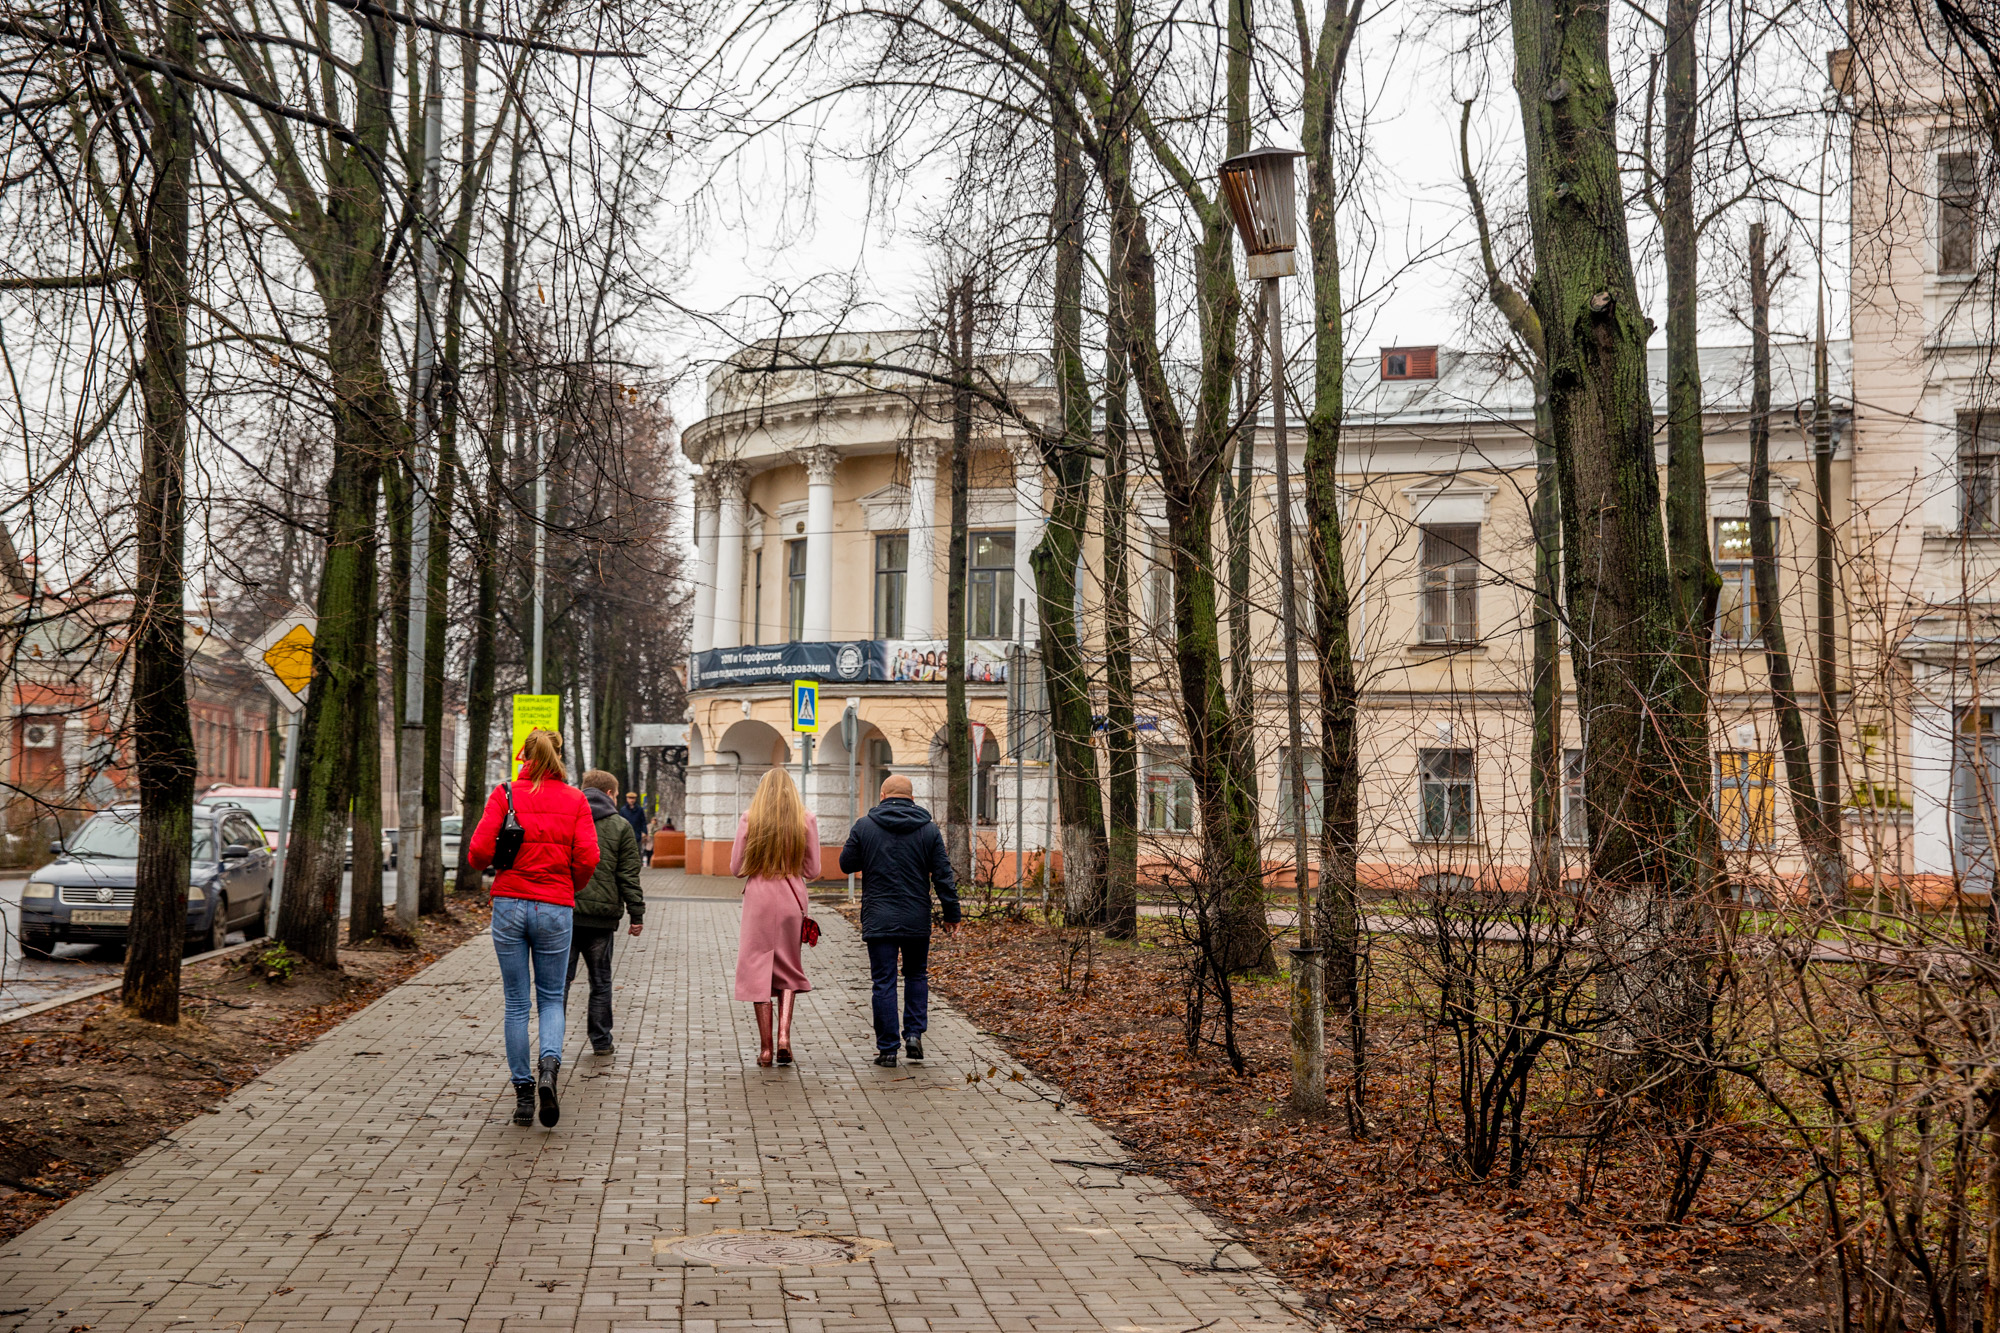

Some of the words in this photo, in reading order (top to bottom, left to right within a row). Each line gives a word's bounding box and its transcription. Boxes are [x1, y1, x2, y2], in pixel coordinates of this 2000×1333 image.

[743, 652, 782, 664] профессия
[719, 667, 771, 679] педагогического
[772, 664, 831, 676] образования
